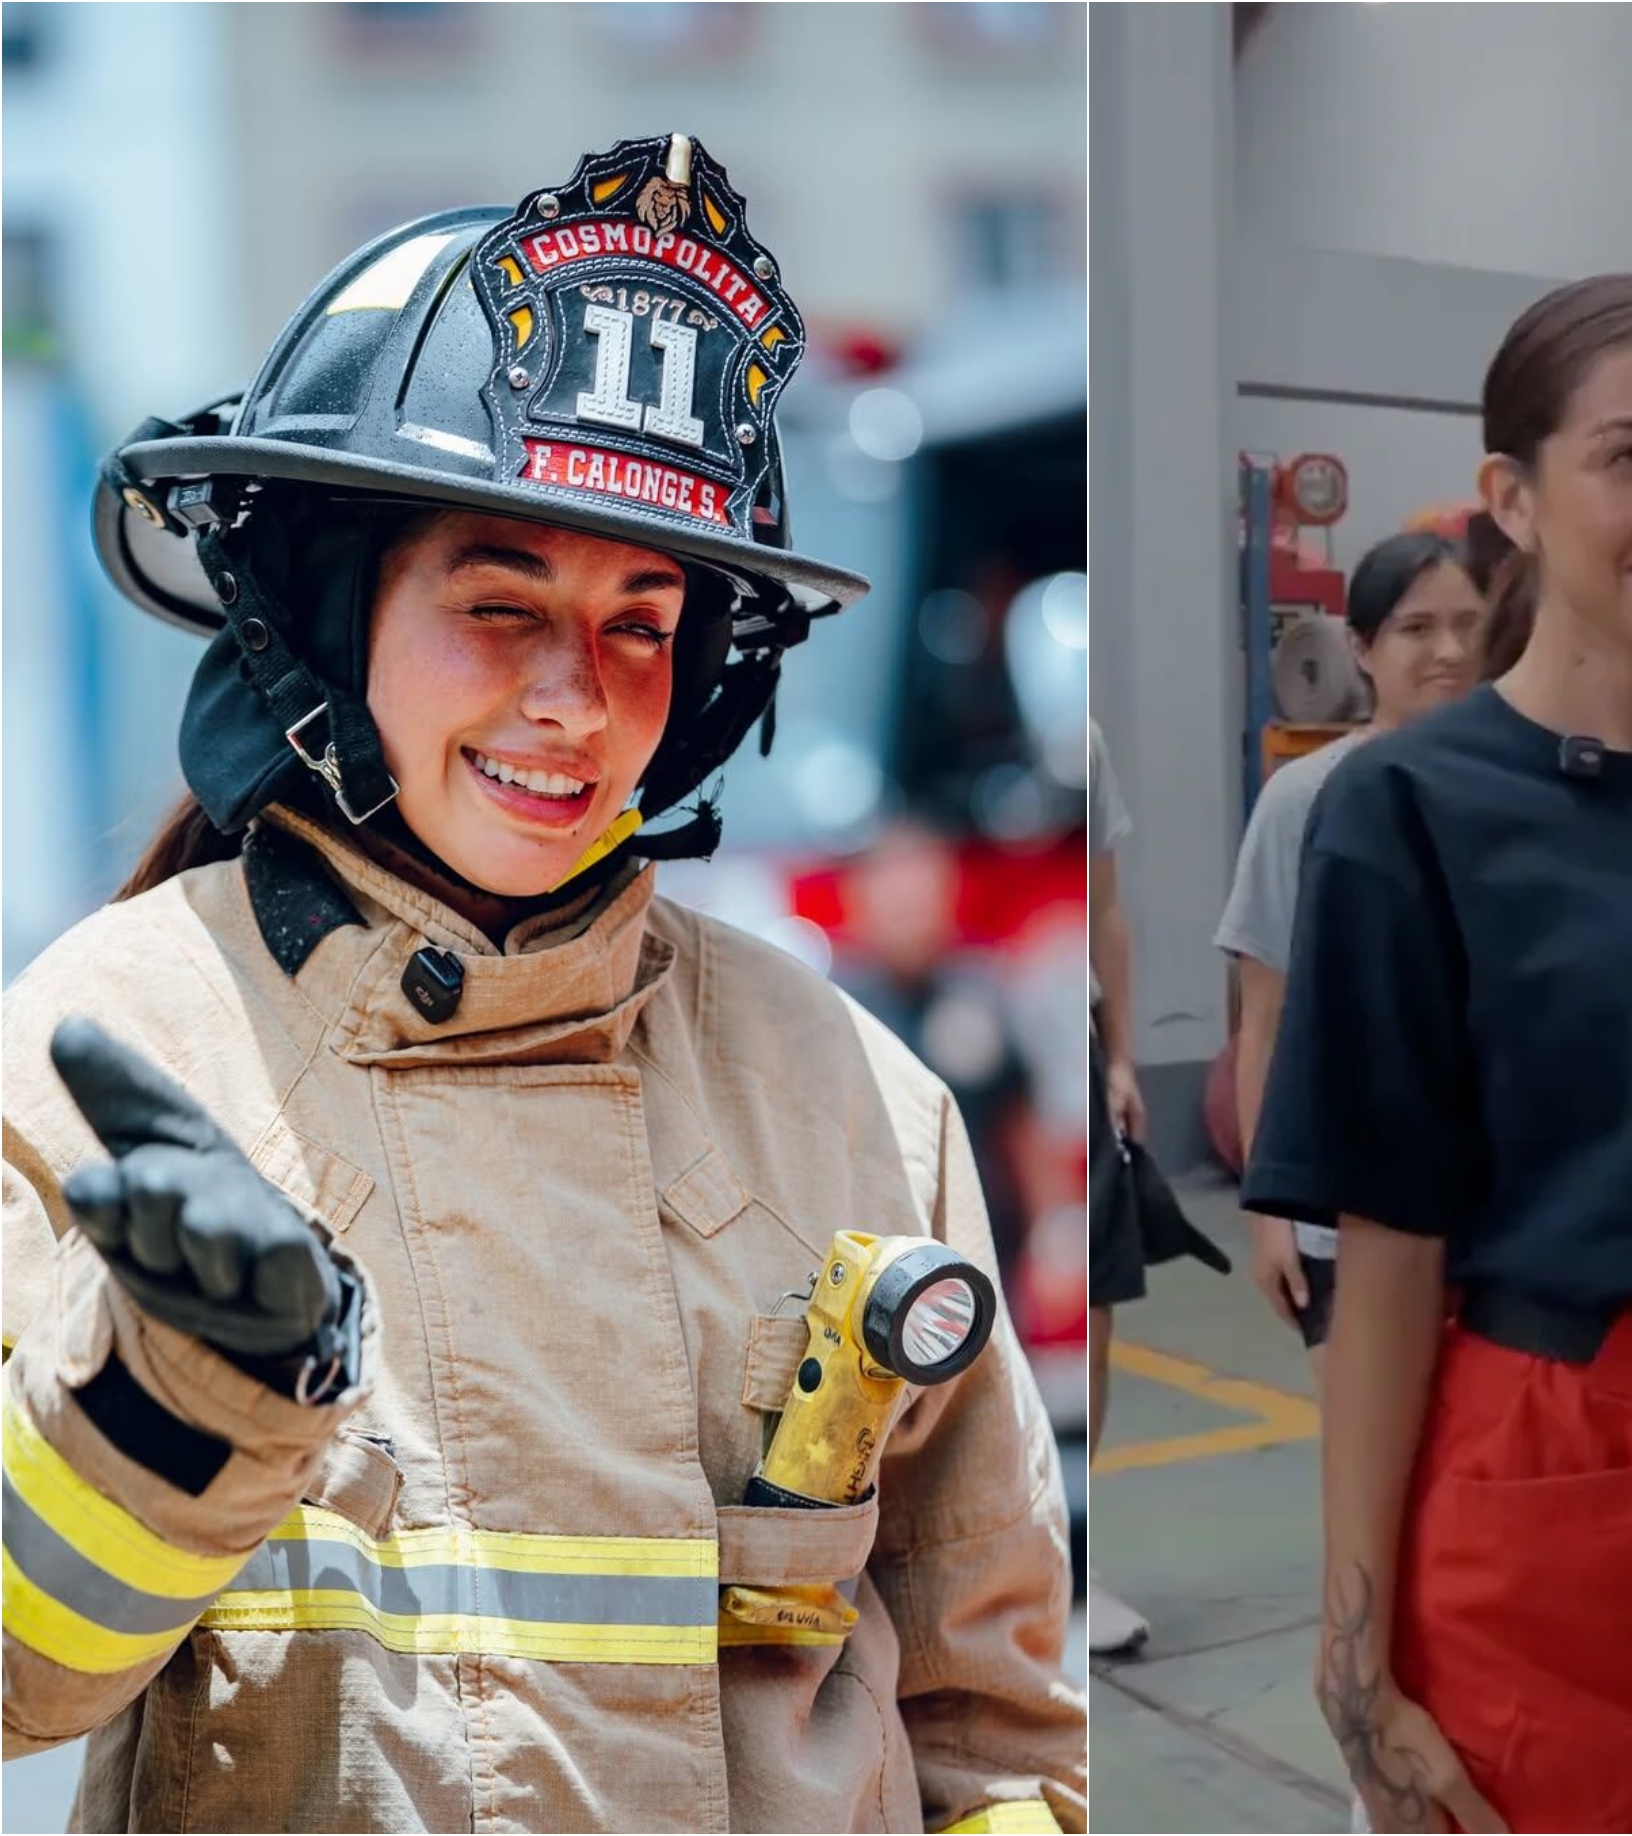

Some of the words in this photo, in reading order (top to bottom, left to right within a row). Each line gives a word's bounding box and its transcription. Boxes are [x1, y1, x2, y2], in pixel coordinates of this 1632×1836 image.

[532, 223, 764, 328] COSMOPOLITA
[616, 287, 688, 323] 1877
[575, 304, 705, 447] 11
[532, 444, 558, 483] F.
[566, 450, 694, 512] CALONGE
[699, 484, 722, 523] S.
